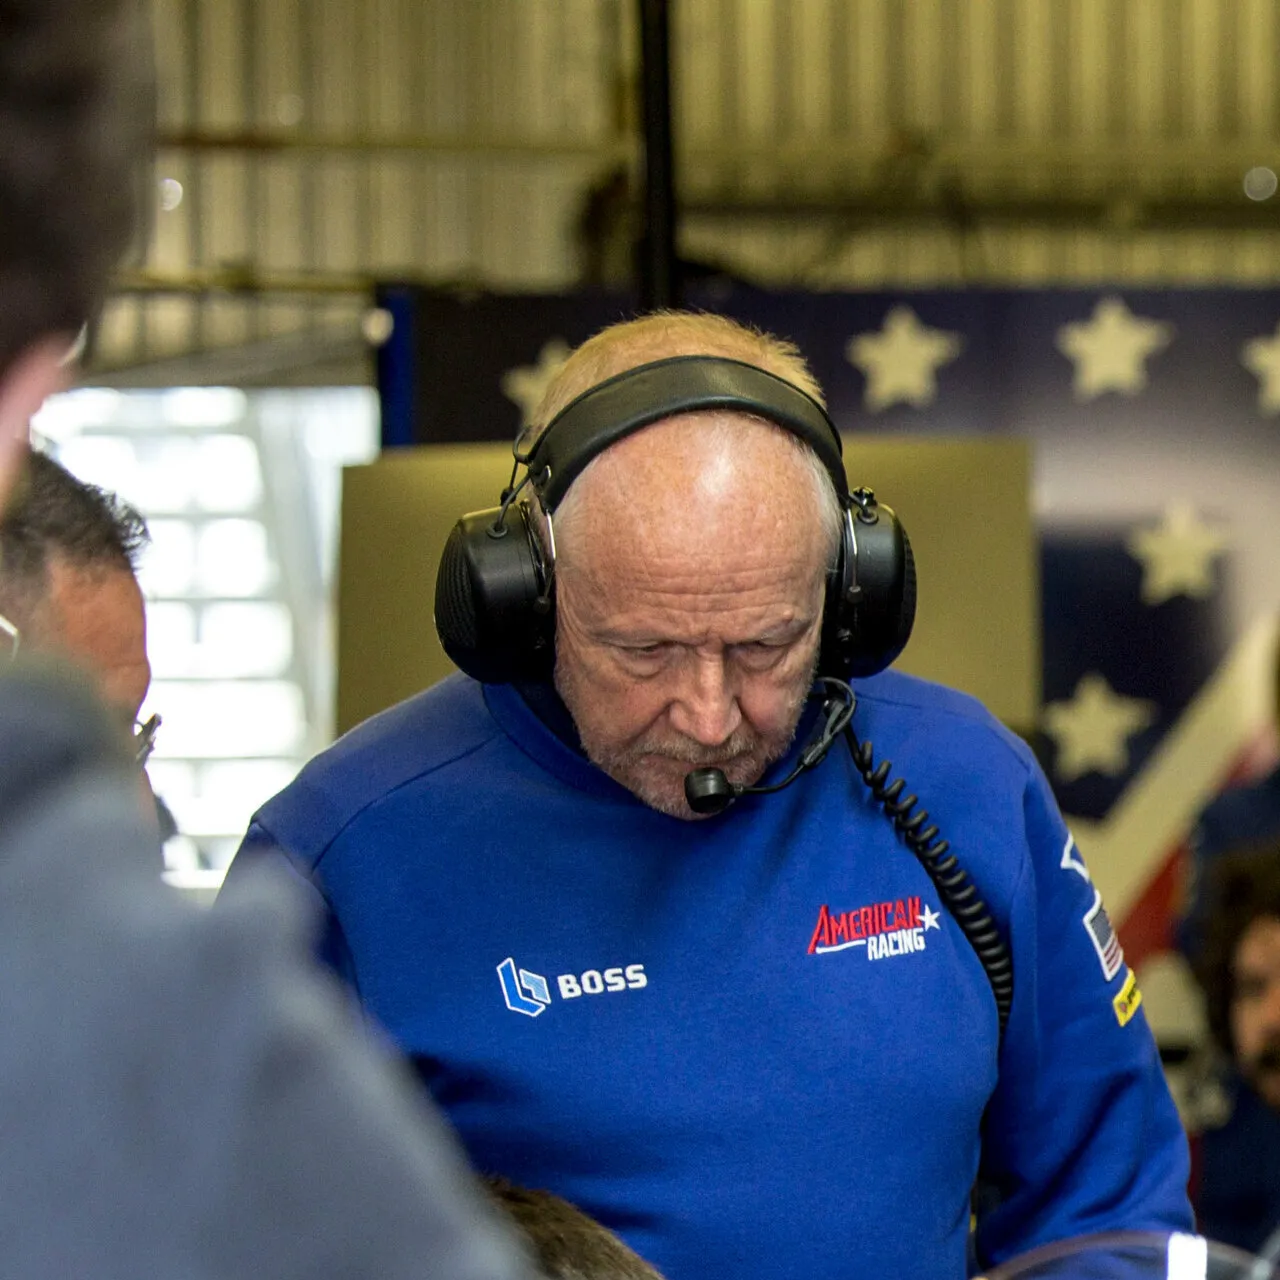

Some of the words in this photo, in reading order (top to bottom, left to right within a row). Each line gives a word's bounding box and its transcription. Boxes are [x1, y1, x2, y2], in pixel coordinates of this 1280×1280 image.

[807, 896, 924, 954] AMERICAN
[867, 927, 926, 961] RACING
[557, 963, 648, 999] BOSS
